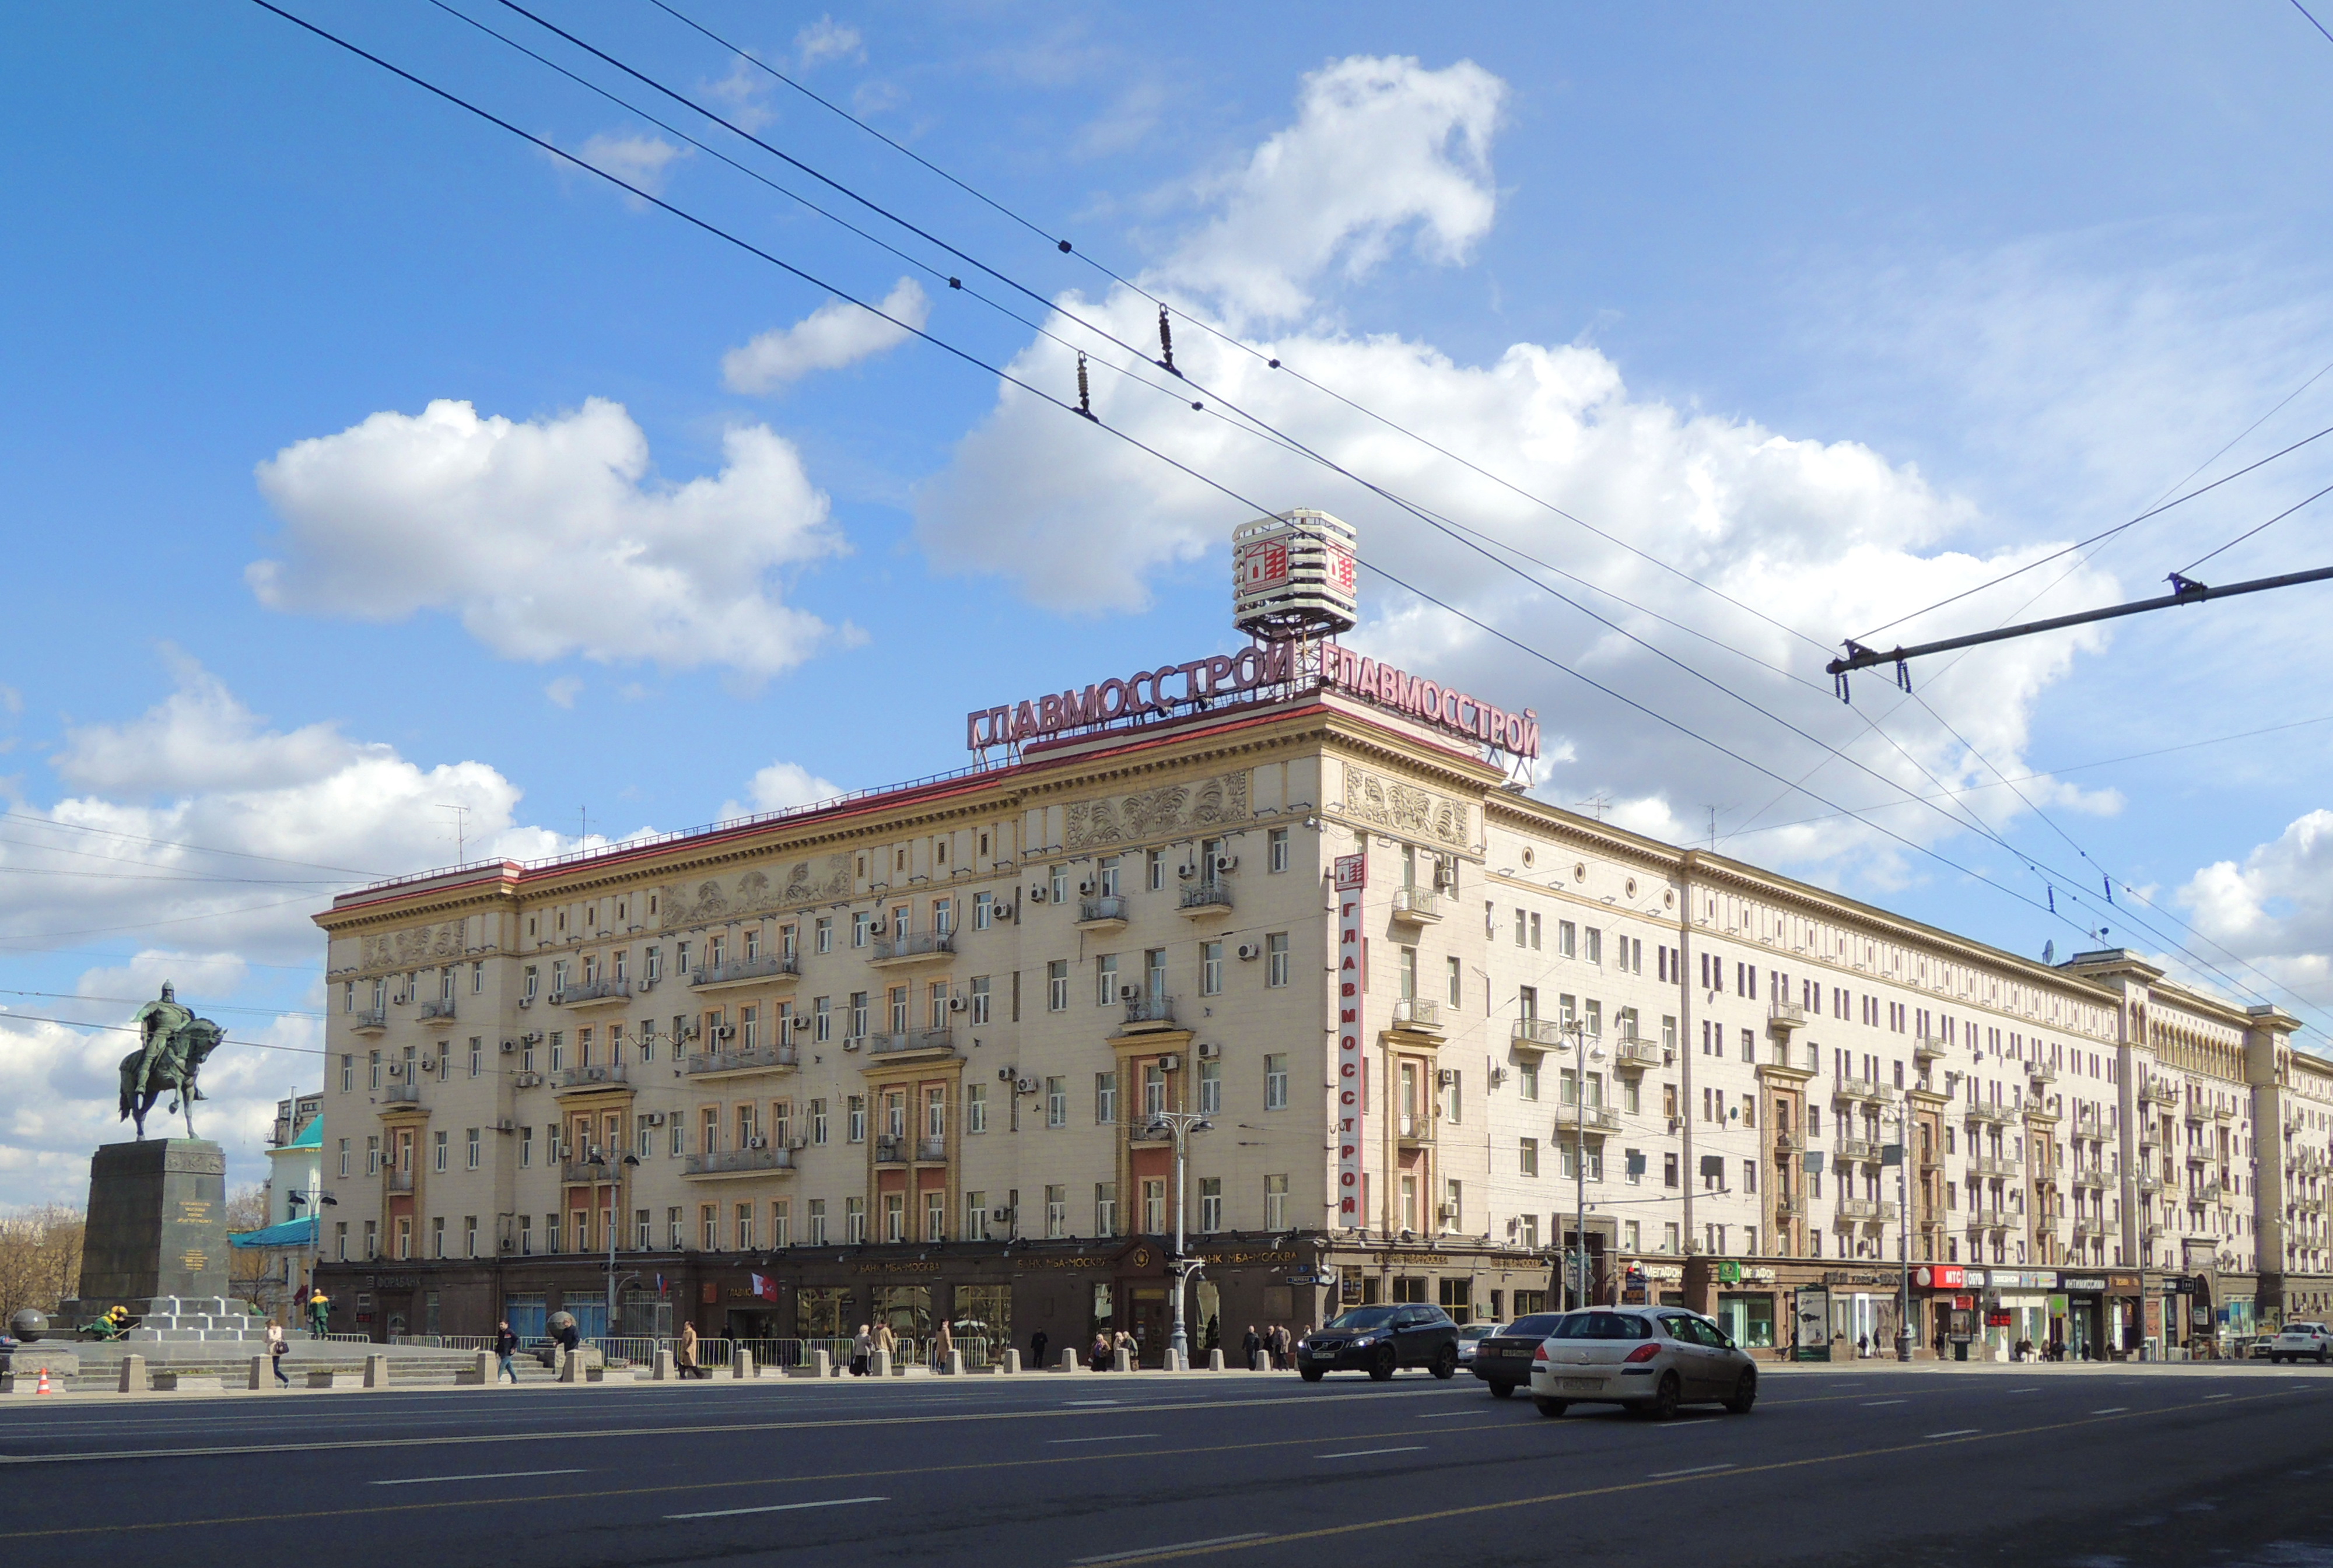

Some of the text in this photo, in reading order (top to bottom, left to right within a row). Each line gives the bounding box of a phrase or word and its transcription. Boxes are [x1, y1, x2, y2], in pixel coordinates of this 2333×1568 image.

[968, 630, 1296, 750] ГЛАВМОССТРОЙ
[1320, 641, 1540, 759] ГЛАВМОССТРОЙ
[1341, 902, 1357, 1213] ГЛАВМОССТРОЙ
[1228, 1251, 1297, 1264] МБА-МОСКВА
[860, 1262, 941, 1273] БАНК МБА-МОСКВА
[1017, 1260, 1042, 1268] БНК
[377, 1276, 421, 1288] ФОРАБАНК
[1945, 1271, 1961, 1283] МТС
